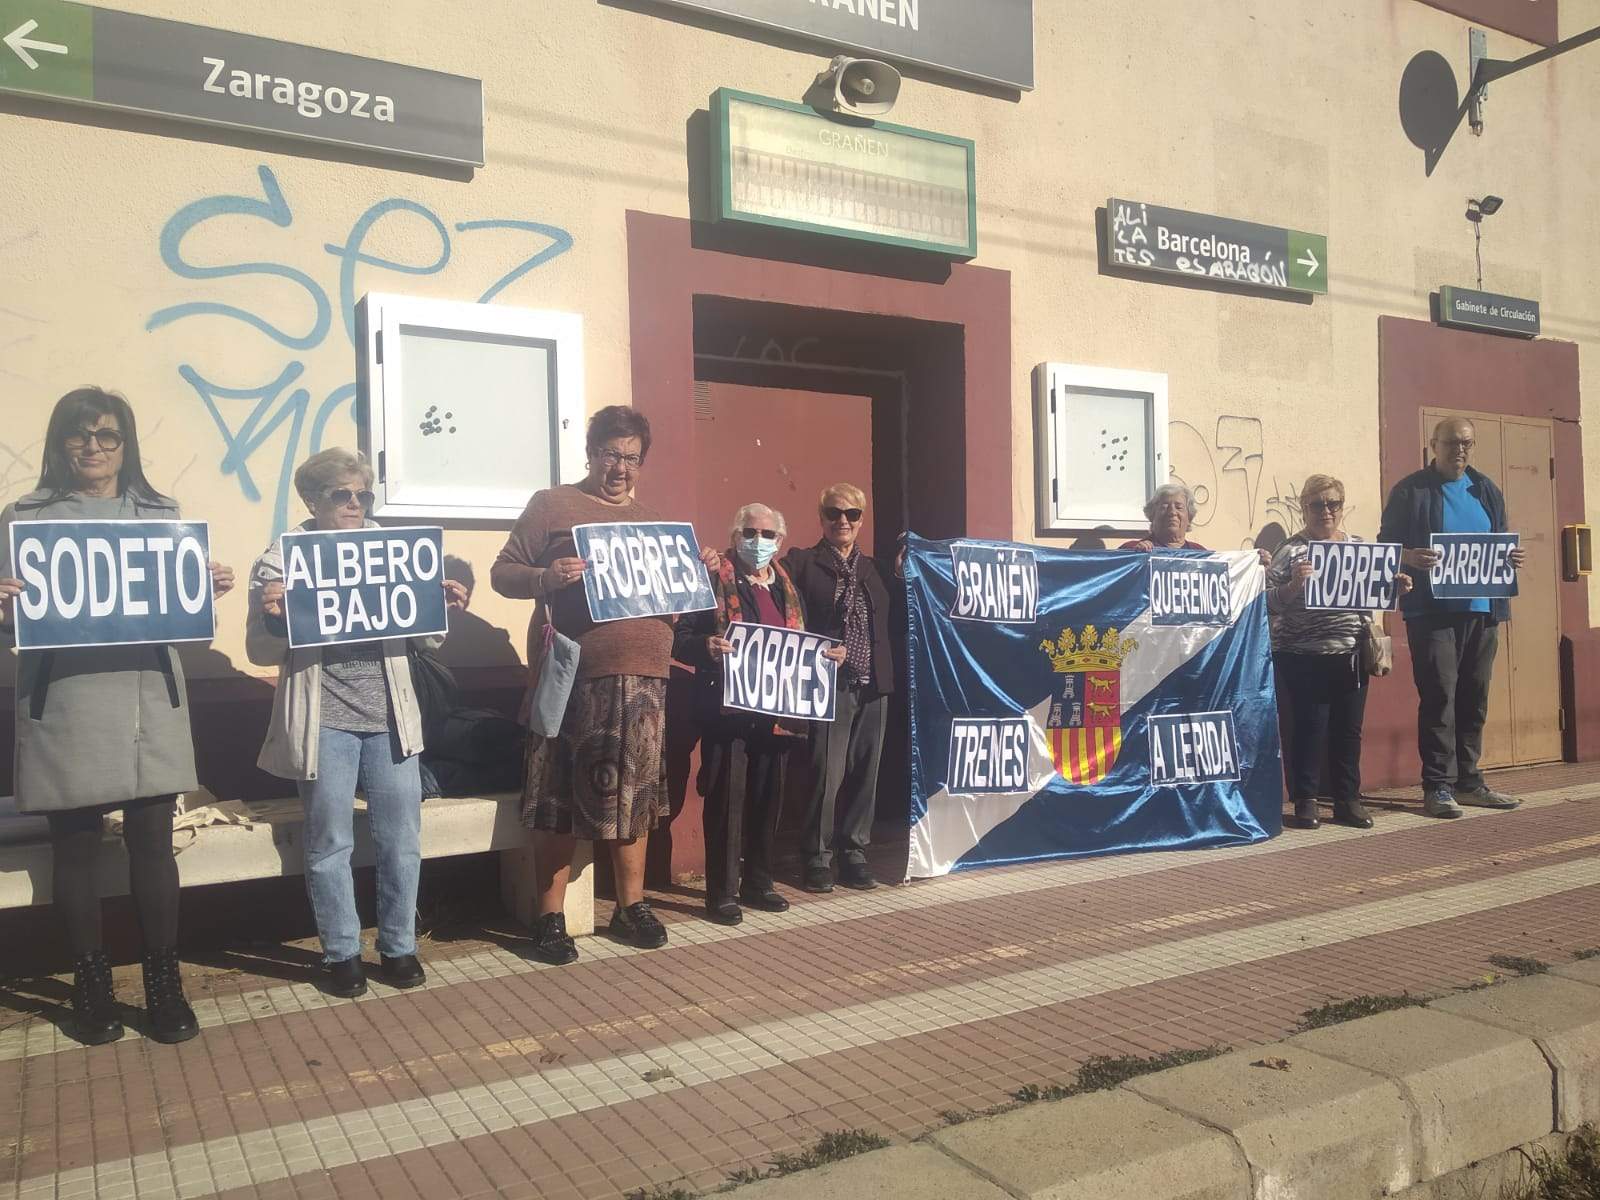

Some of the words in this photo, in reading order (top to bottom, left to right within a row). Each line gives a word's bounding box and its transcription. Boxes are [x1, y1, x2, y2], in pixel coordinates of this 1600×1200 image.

[203, 56, 394, 122] Zaragoza
[818, 129, 888, 158] GRAÑEN
[1157, 226, 1250, 263] Barcelona
[1455, 300, 1487, 314] Gabinete
[1489, 306, 1498, 316] de
[1500, 307, 1536, 322] Circulación
[18, 536, 208, 620] SODETO
[286, 537, 439, 590] ALBERO
[588, 533, 698, 601] ROBRES
[957, 553, 1036, 620] GRAÑEN
[1307, 544, 1396, 608] ROBRES
[1432, 542, 1516, 585] BARBUES
[317, 584, 417, 636] BAJO
[1151, 571, 1228, 616] QUEREMOS
[729, 626, 833, 717] ROBRES
[952, 724, 1026, 788] TRENES
[1153, 736, 1166, 780] A
[1172, 721, 1235, 778] LERIDA
